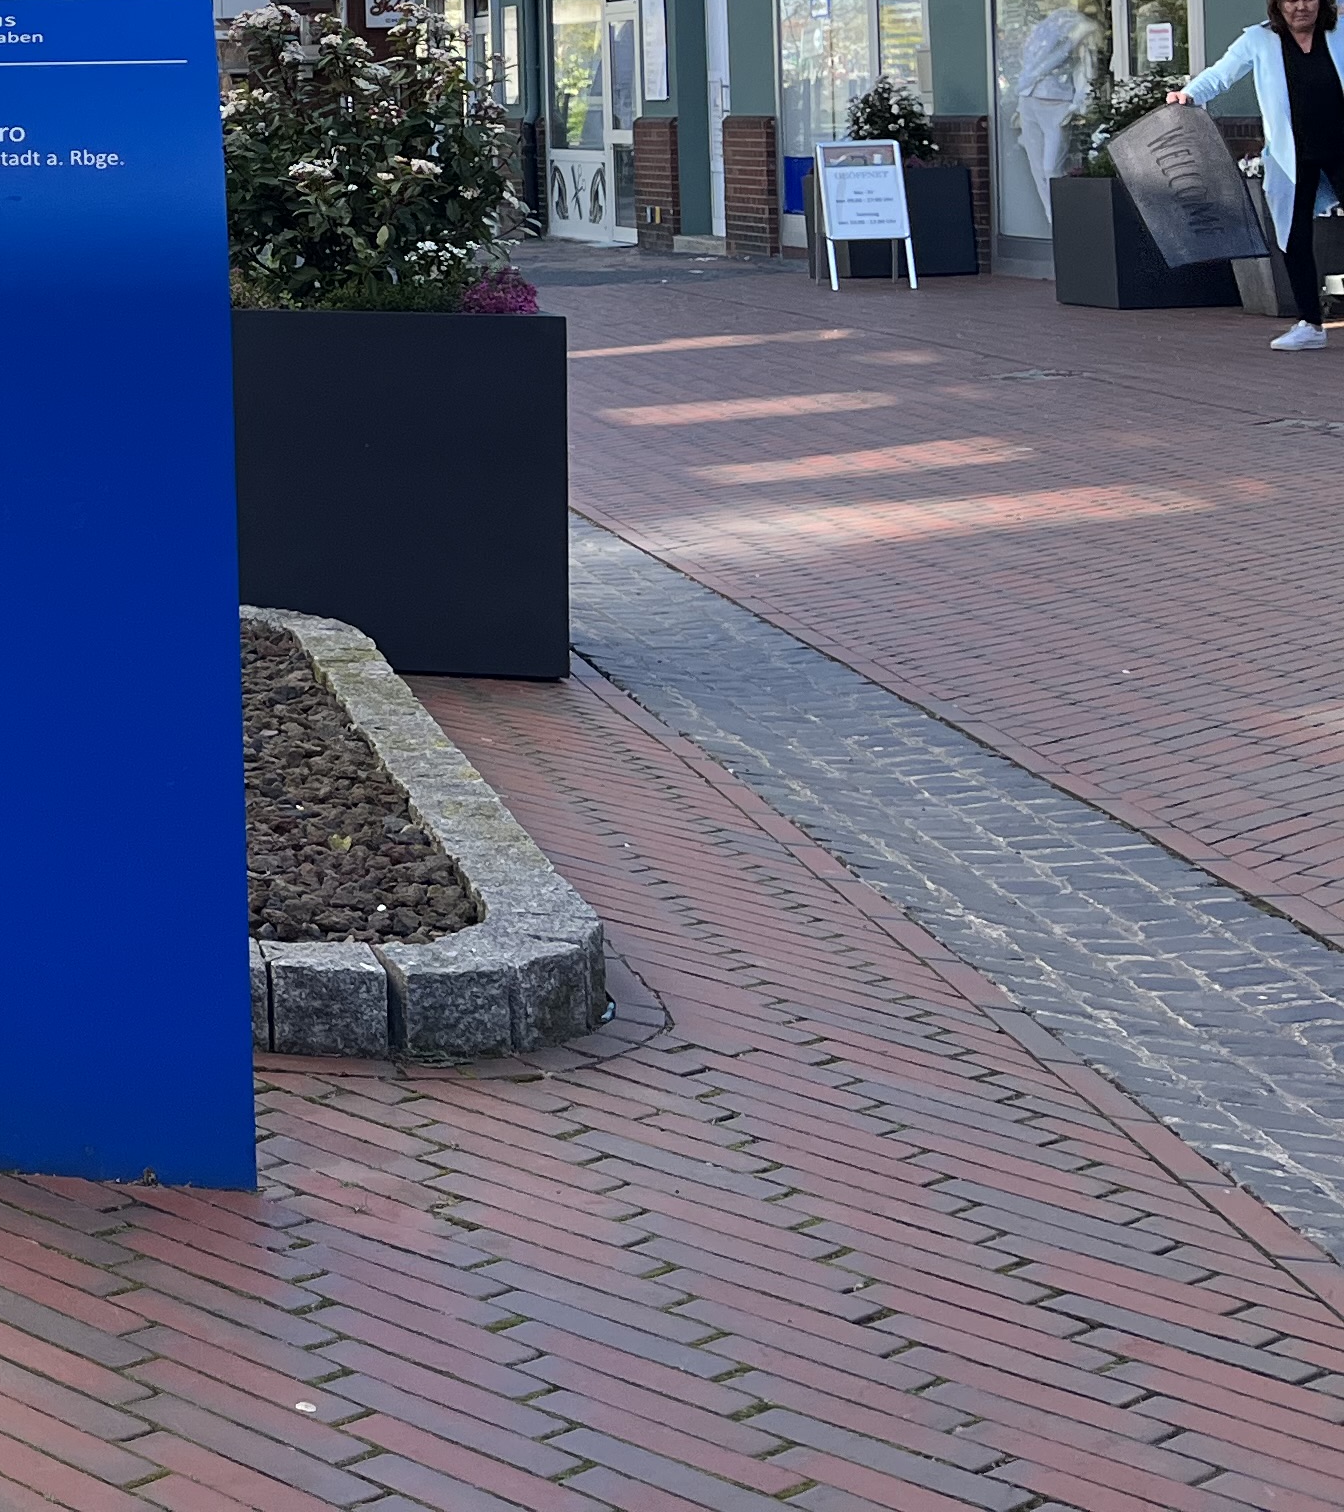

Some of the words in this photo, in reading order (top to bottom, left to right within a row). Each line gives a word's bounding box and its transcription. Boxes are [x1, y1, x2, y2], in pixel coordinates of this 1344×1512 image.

[46, 152, 64, 167] a.
[70, 148, 125, 170] Rbge.
[1147, 125, 1226, 234] WELCOME
